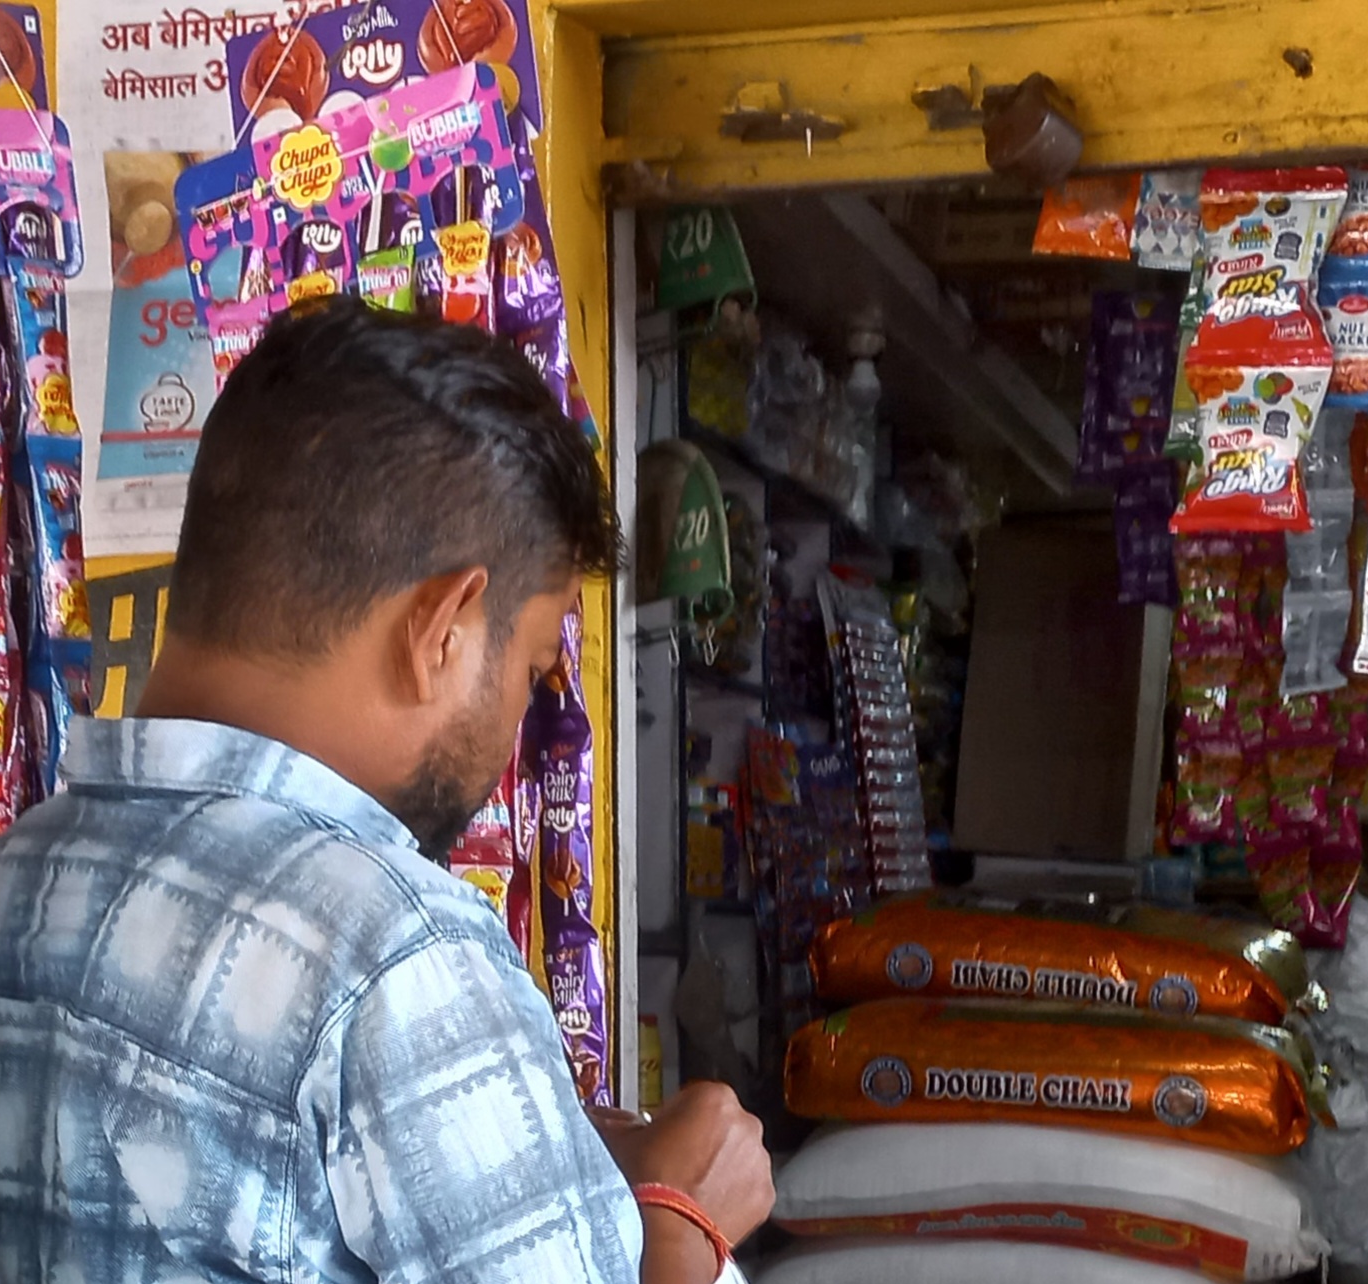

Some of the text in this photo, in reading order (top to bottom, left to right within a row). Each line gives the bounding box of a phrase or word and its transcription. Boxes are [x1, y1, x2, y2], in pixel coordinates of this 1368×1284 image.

[101, 22, 150, 50] अब
[340, 37, 404, 83] Lolly
[102, 68, 196, 100] बेमिसाल
[408, 104, 481, 146] BUBBLE
[279, 144, 332, 169] Chupa
[279, 165, 333, 193] Chups
[1221, 267, 1284, 300] Star
[1338, 322, 1366, 335] NUT
[552, 973, 585, 995] Dairy
[951, 960, 1139, 1006] CHABI DOUBLE
[925, 1068, 1131, 1112] DOUBLE CHABI
